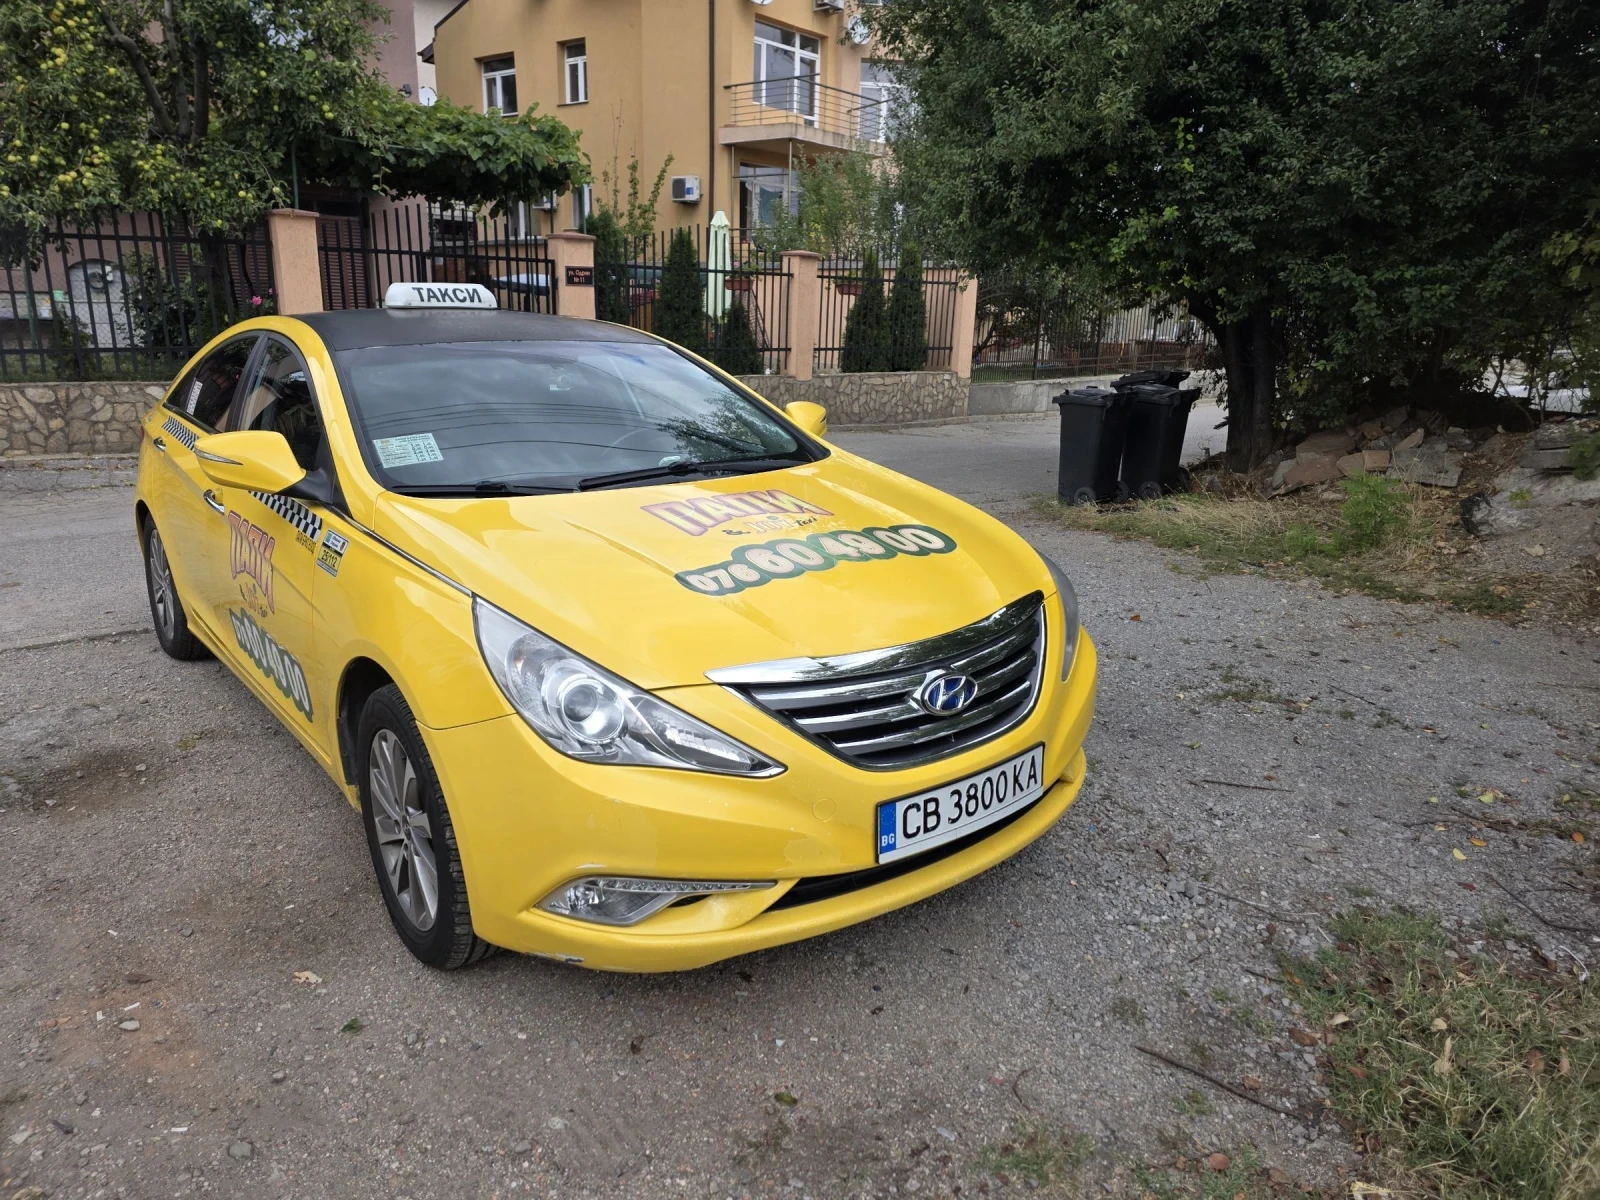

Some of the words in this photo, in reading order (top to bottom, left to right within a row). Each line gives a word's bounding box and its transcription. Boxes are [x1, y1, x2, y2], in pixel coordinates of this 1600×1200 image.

[412, 286, 483, 304] ТАКСИ
[640, 489, 835, 537] ПАПИ
[948, 769, 1008, 825] 3800
[881, 833, 895, 847] BG
